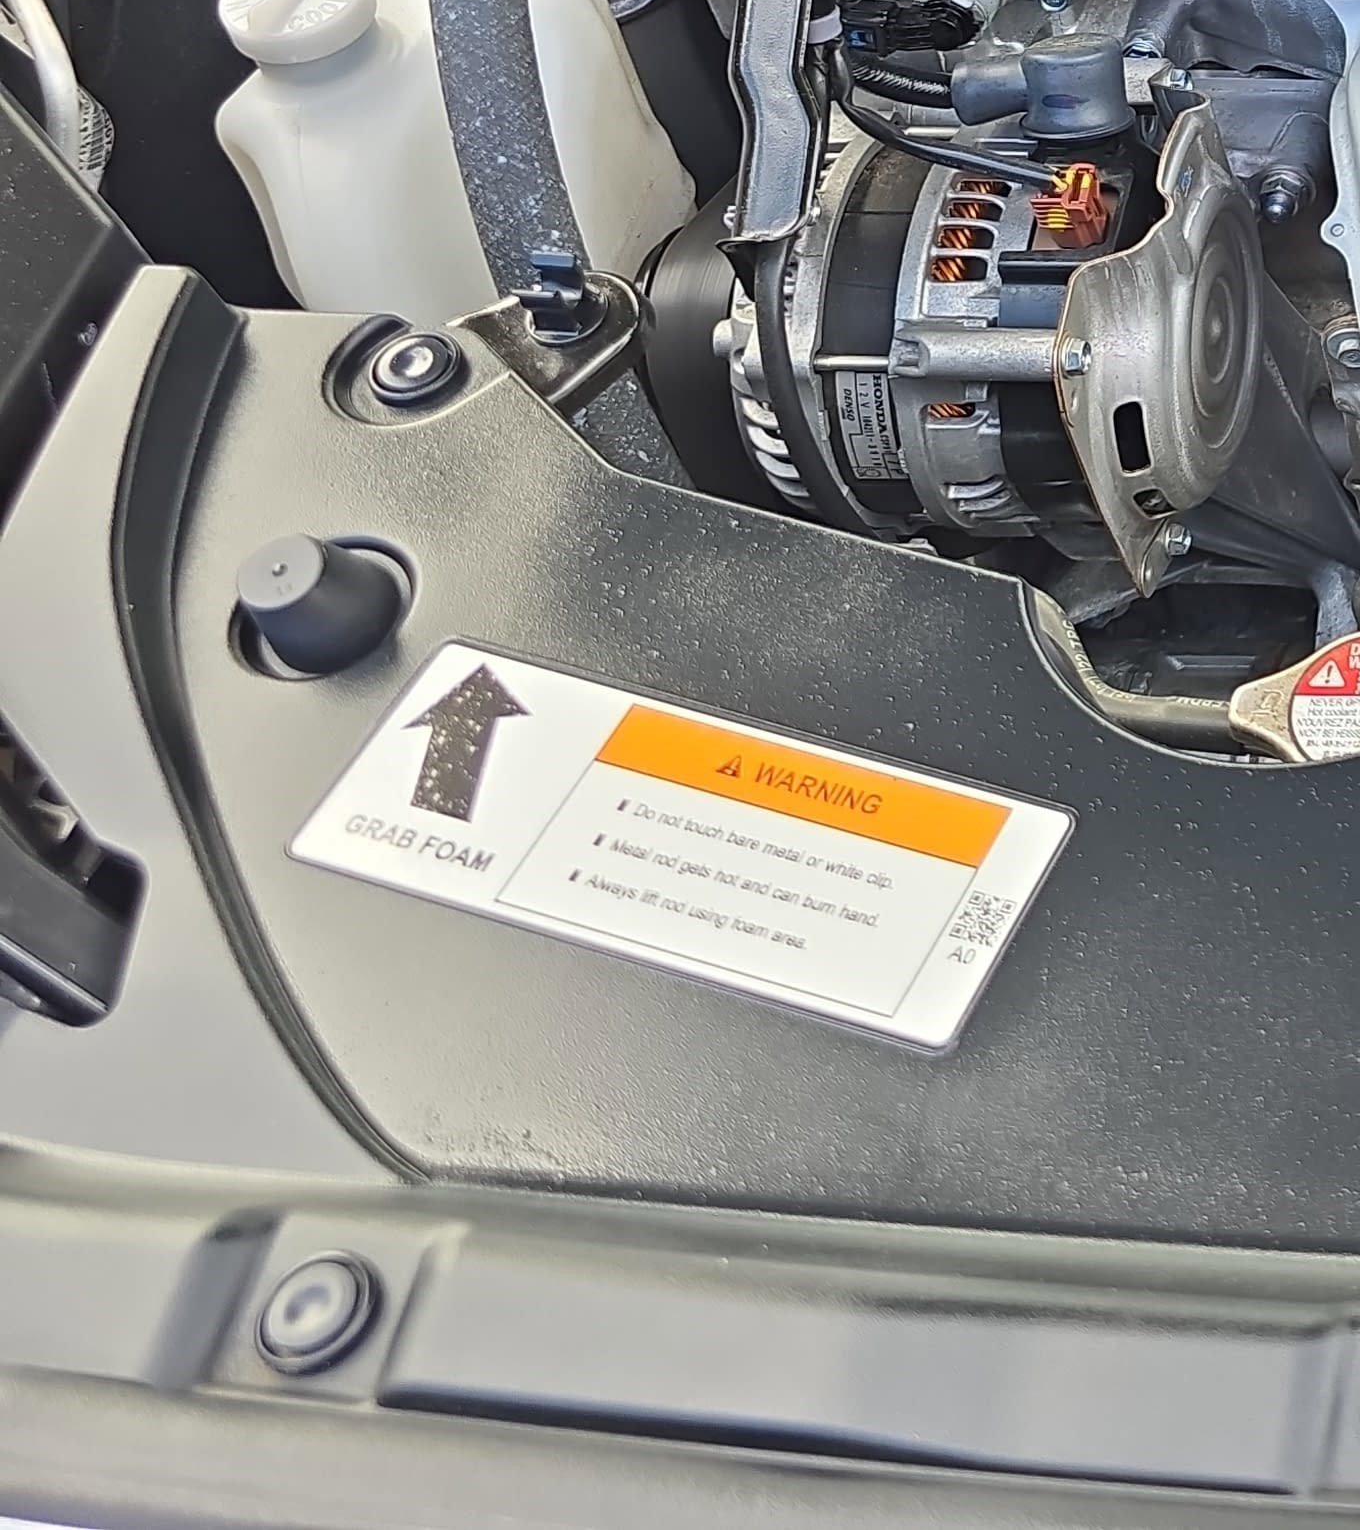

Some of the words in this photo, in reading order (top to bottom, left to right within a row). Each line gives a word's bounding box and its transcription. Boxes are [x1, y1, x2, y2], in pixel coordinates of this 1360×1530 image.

[843, 388, 856, 422] DENSO
[873, 374, 888, 434] HONDA
[753, 762, 886, 817] WARNING
[345, 813, 418, 850] GRAB
[418, 835, 496, 872] FOAM
[633, 802, 656, 821] Do
[657, 811, 684, 828] not
[684, 817, 724, 841] touch
[725, 828, 761, 851] bare
[763, 841, 805, 863] metal
[805, 856, 823, 871] or
[824, 859, 864, 882] white
[866, 871, 895, 892] clip.
[583, 872, 638, 902] Always
[640, 885, 660, 906] lift
[660, 894, 686, 915] rod
[687, 901, 728, 931] using
[729, 913, 768, 938] foam
[769, 928, 809, 951] area.
[609, 837, 649, 861] Metal
[652, 849, 680, 867] rod
[678, 858, 711, 883] gets
[741, 878, 771, 897] and
[771, 887, 800, 906] can
[802, 893, 836, 915] burn
[837, 902, 881, 928] hand.
